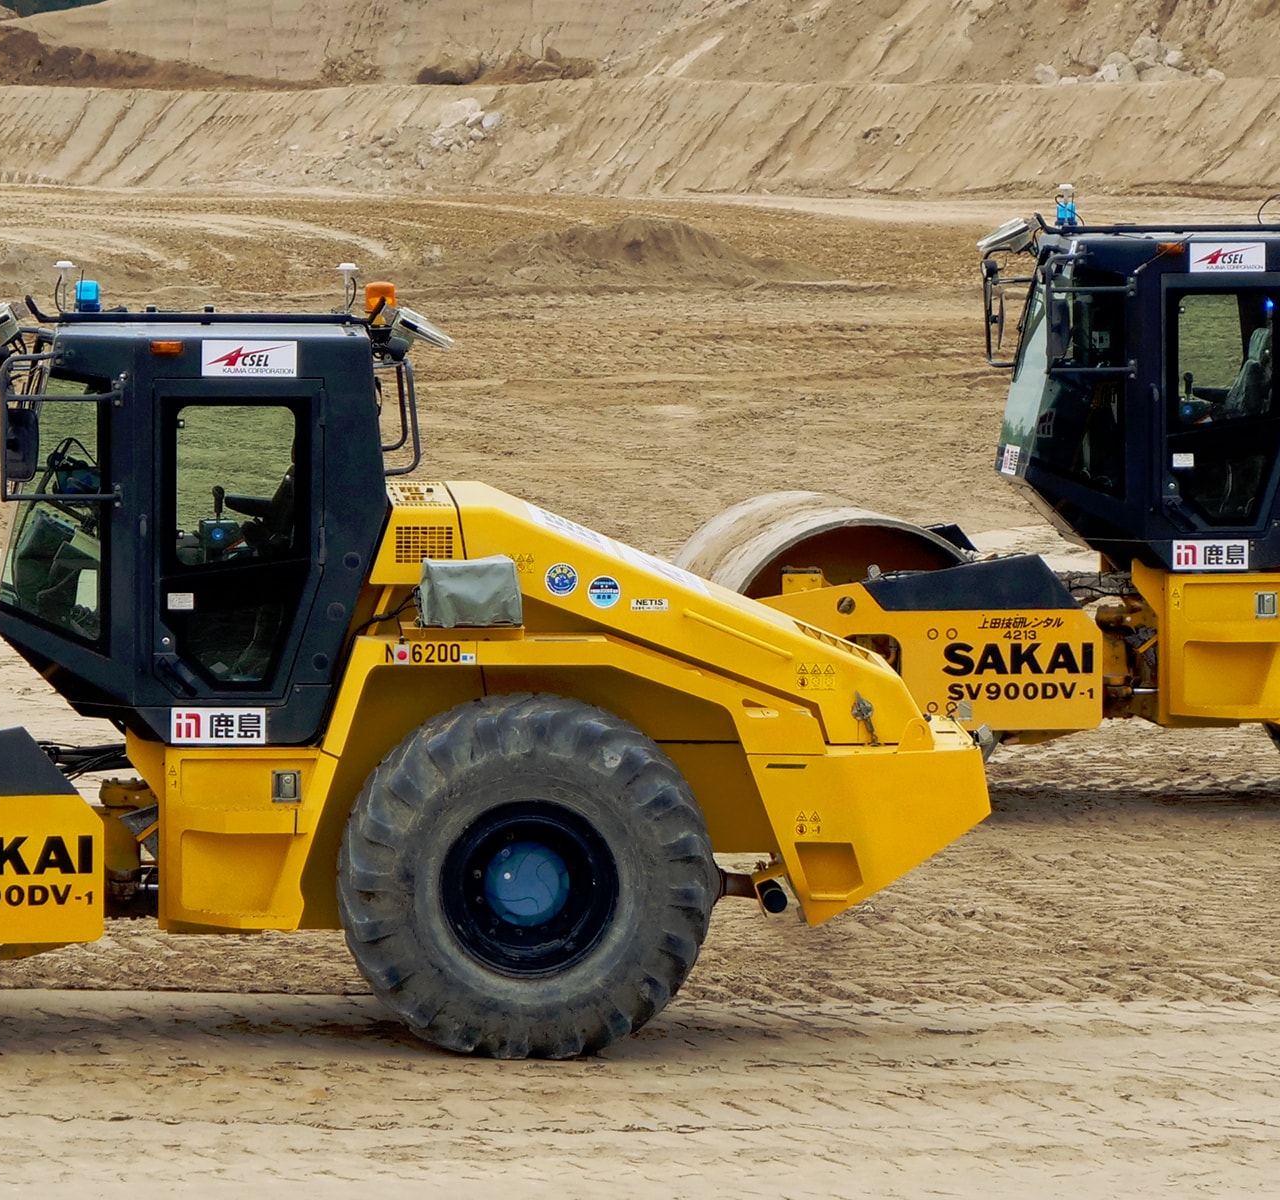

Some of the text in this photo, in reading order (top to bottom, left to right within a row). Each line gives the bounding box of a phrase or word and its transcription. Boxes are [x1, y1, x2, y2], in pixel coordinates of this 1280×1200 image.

[1203, 544, 1245, 565] 鹿島
[977, 617, 1064, 630] 上田技研レンタル
[1003, 630, 1037, 640] 4213
[942, 642, 1094, 677] SAKAI
[947, 682, 1094, 701] SV900DV-1
[209, 713, 261, 738] 鹿島
